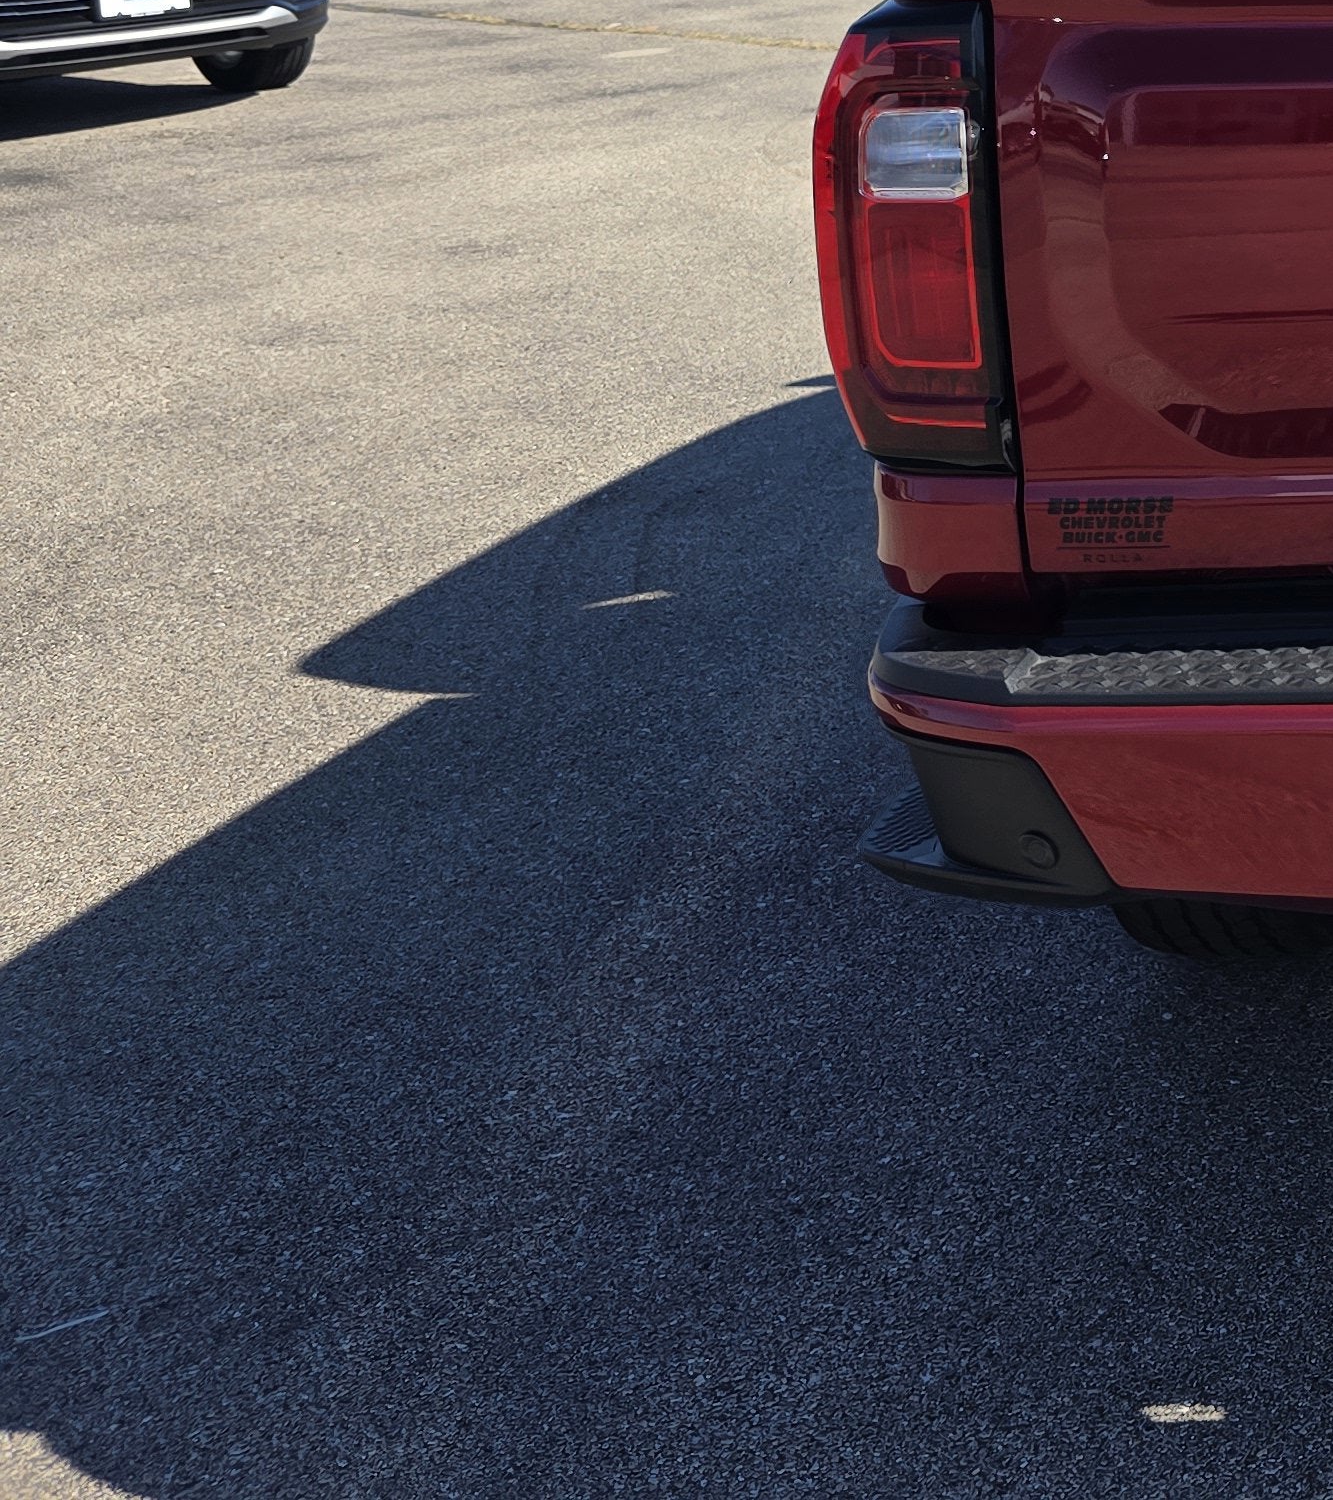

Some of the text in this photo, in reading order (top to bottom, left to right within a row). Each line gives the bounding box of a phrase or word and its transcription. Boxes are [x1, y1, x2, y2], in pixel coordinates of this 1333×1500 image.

[1048, 495, 1174, 515] ED MORSE
[1059, 515, 1167, 530] CHEVROLET
[1083, 552, 1144, 564] ROLLA
